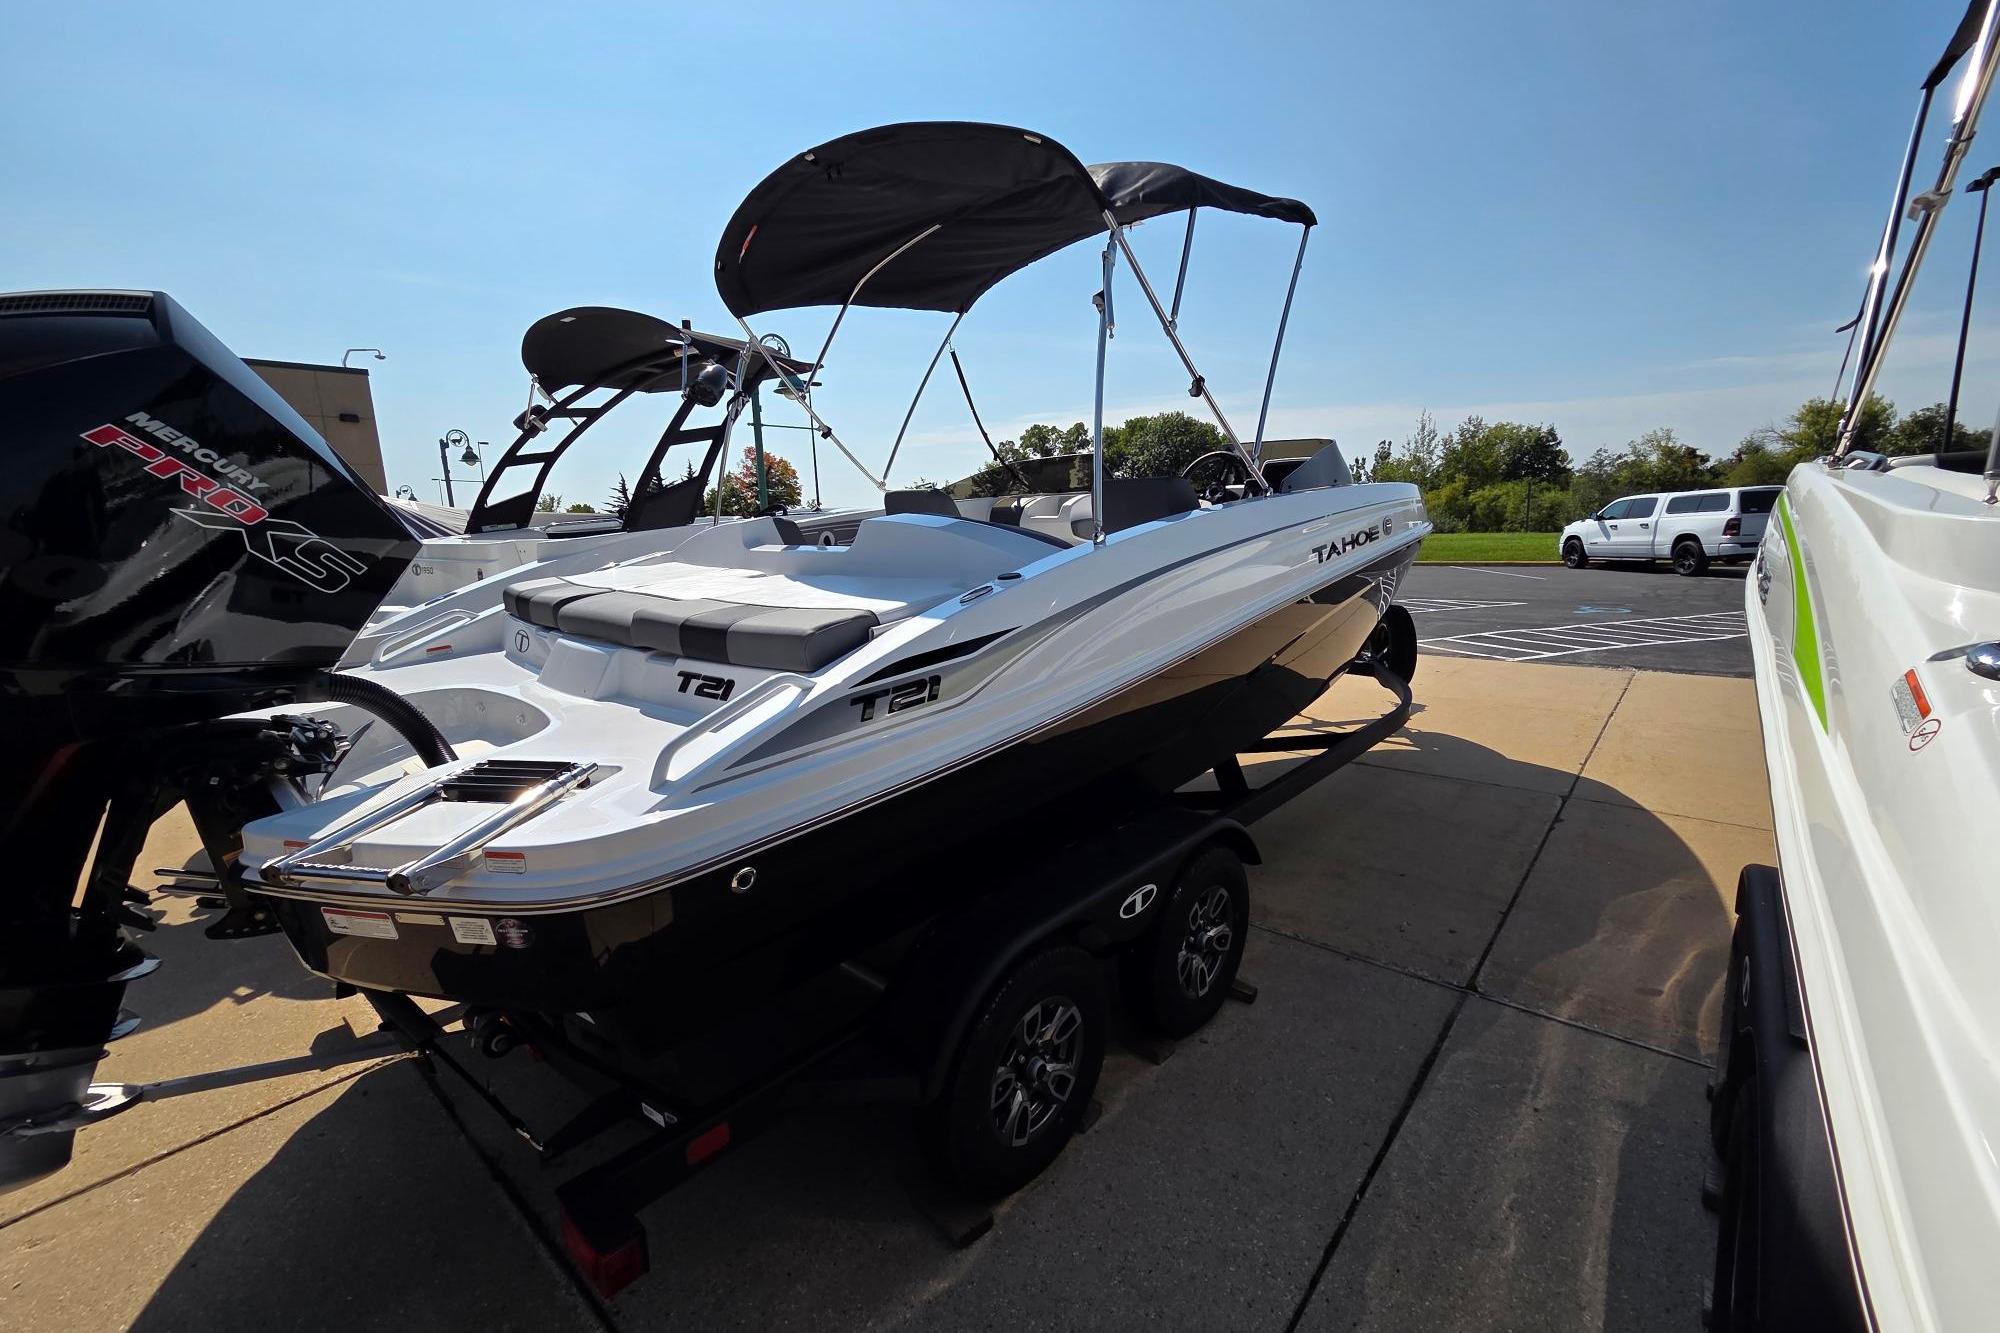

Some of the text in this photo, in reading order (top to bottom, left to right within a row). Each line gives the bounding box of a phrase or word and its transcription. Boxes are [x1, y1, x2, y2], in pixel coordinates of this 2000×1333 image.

[80, 424, 270, 525] PRO
[126, 411, 270, 491] MERCURY
[169, 507, 369, 593] XS
[1311, 525, 1380, 564] TAHOE
[677, 671, 736, 702] T21
[850, 675, 942, 722] T21
